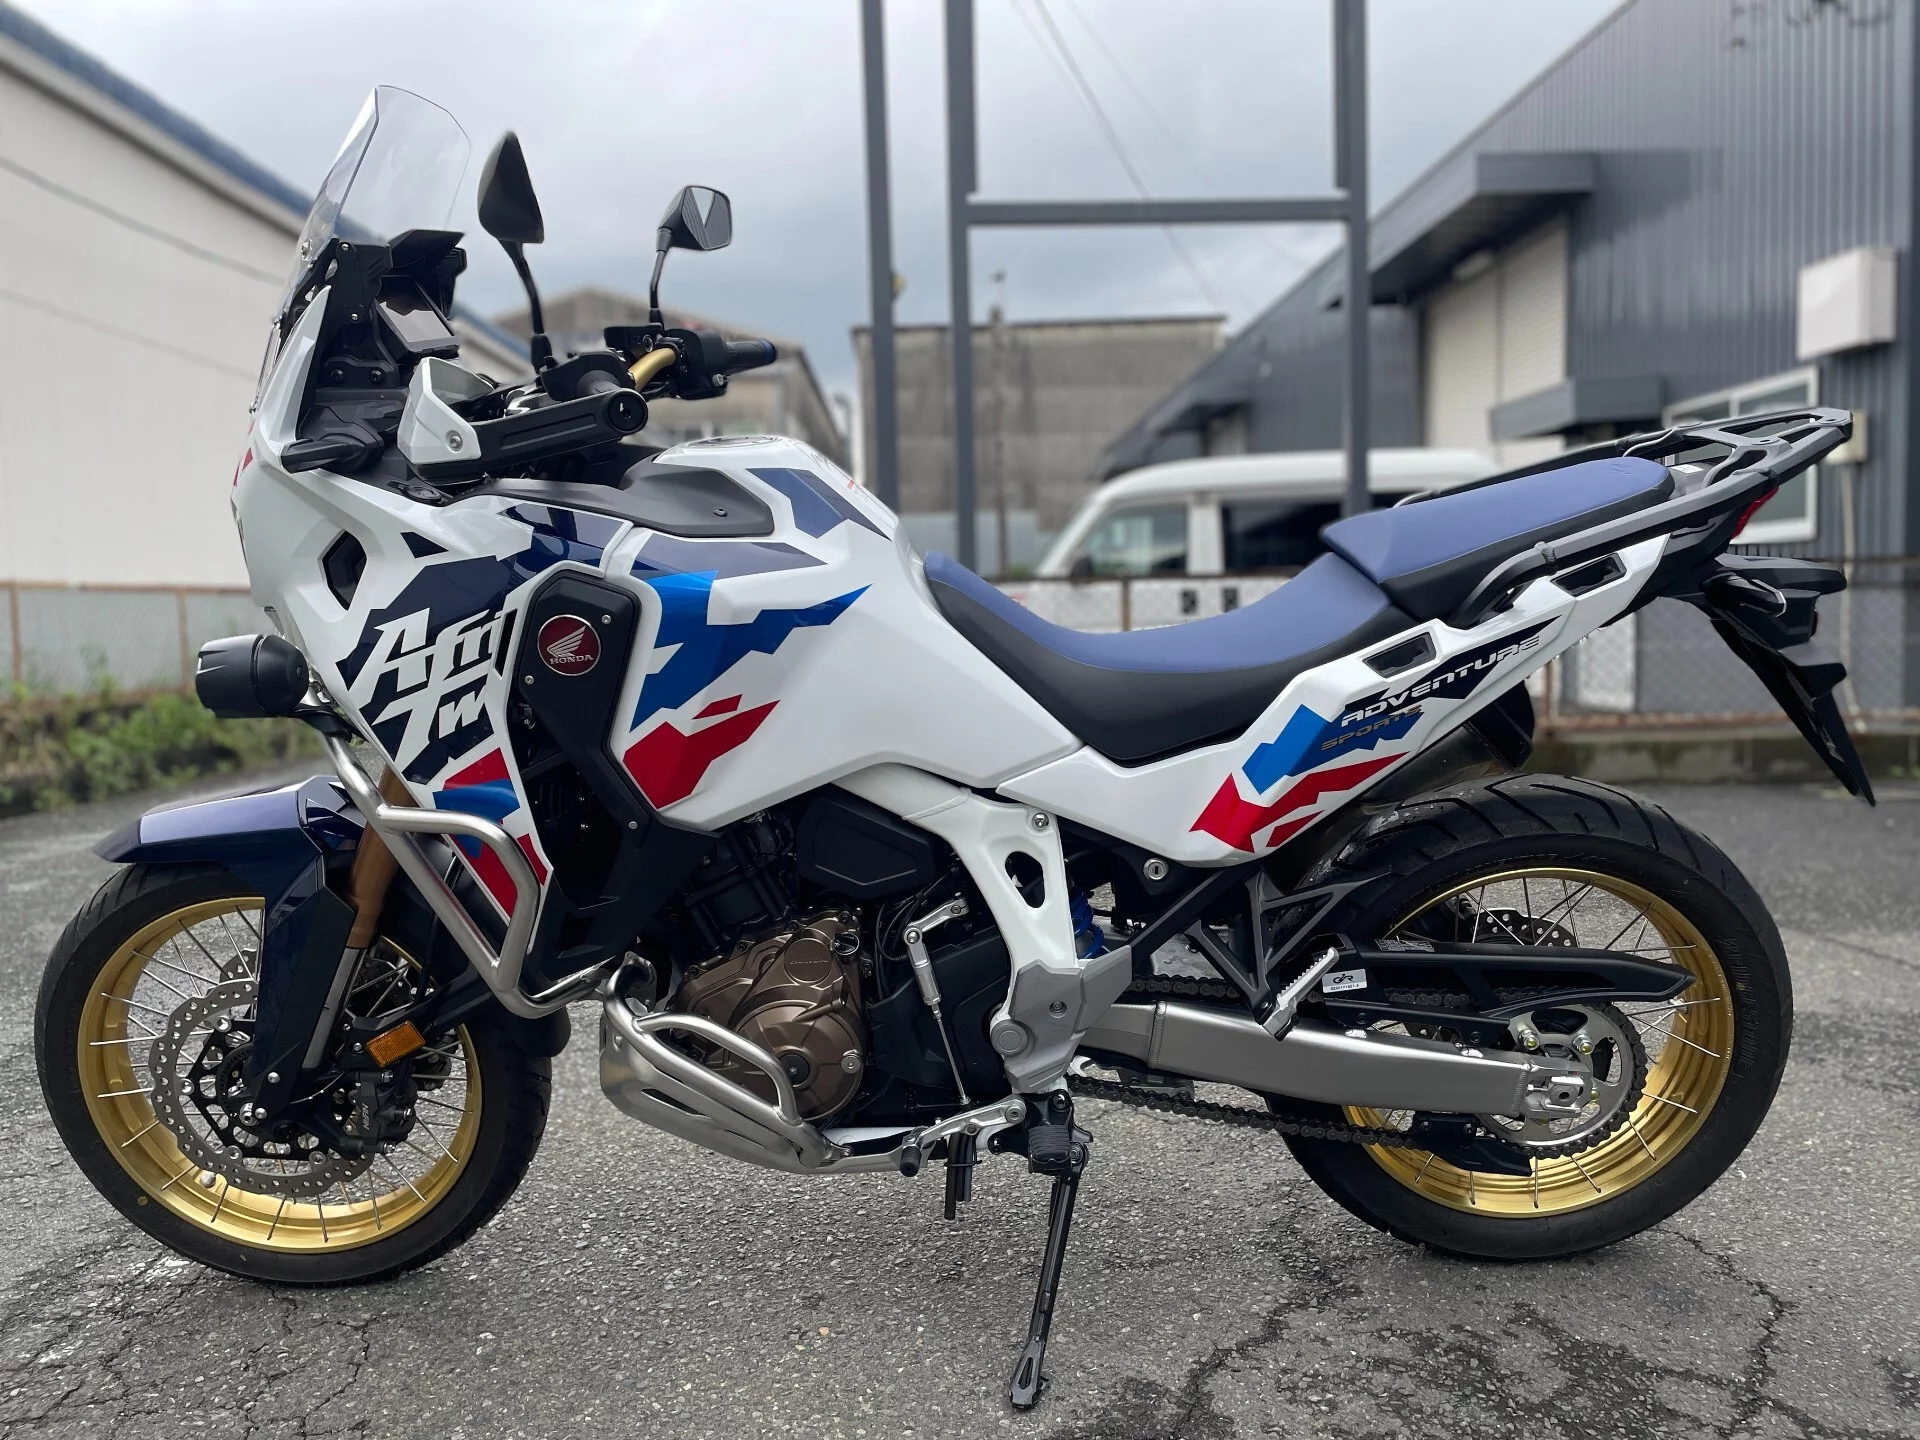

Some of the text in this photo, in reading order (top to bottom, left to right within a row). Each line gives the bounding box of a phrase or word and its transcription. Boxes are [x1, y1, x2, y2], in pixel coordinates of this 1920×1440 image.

[550, 654, 594, 664] HONDA
[1341, 635, 1540, 727] ADVENTURE
[1321, 704, 1423, 750] SPORTS
